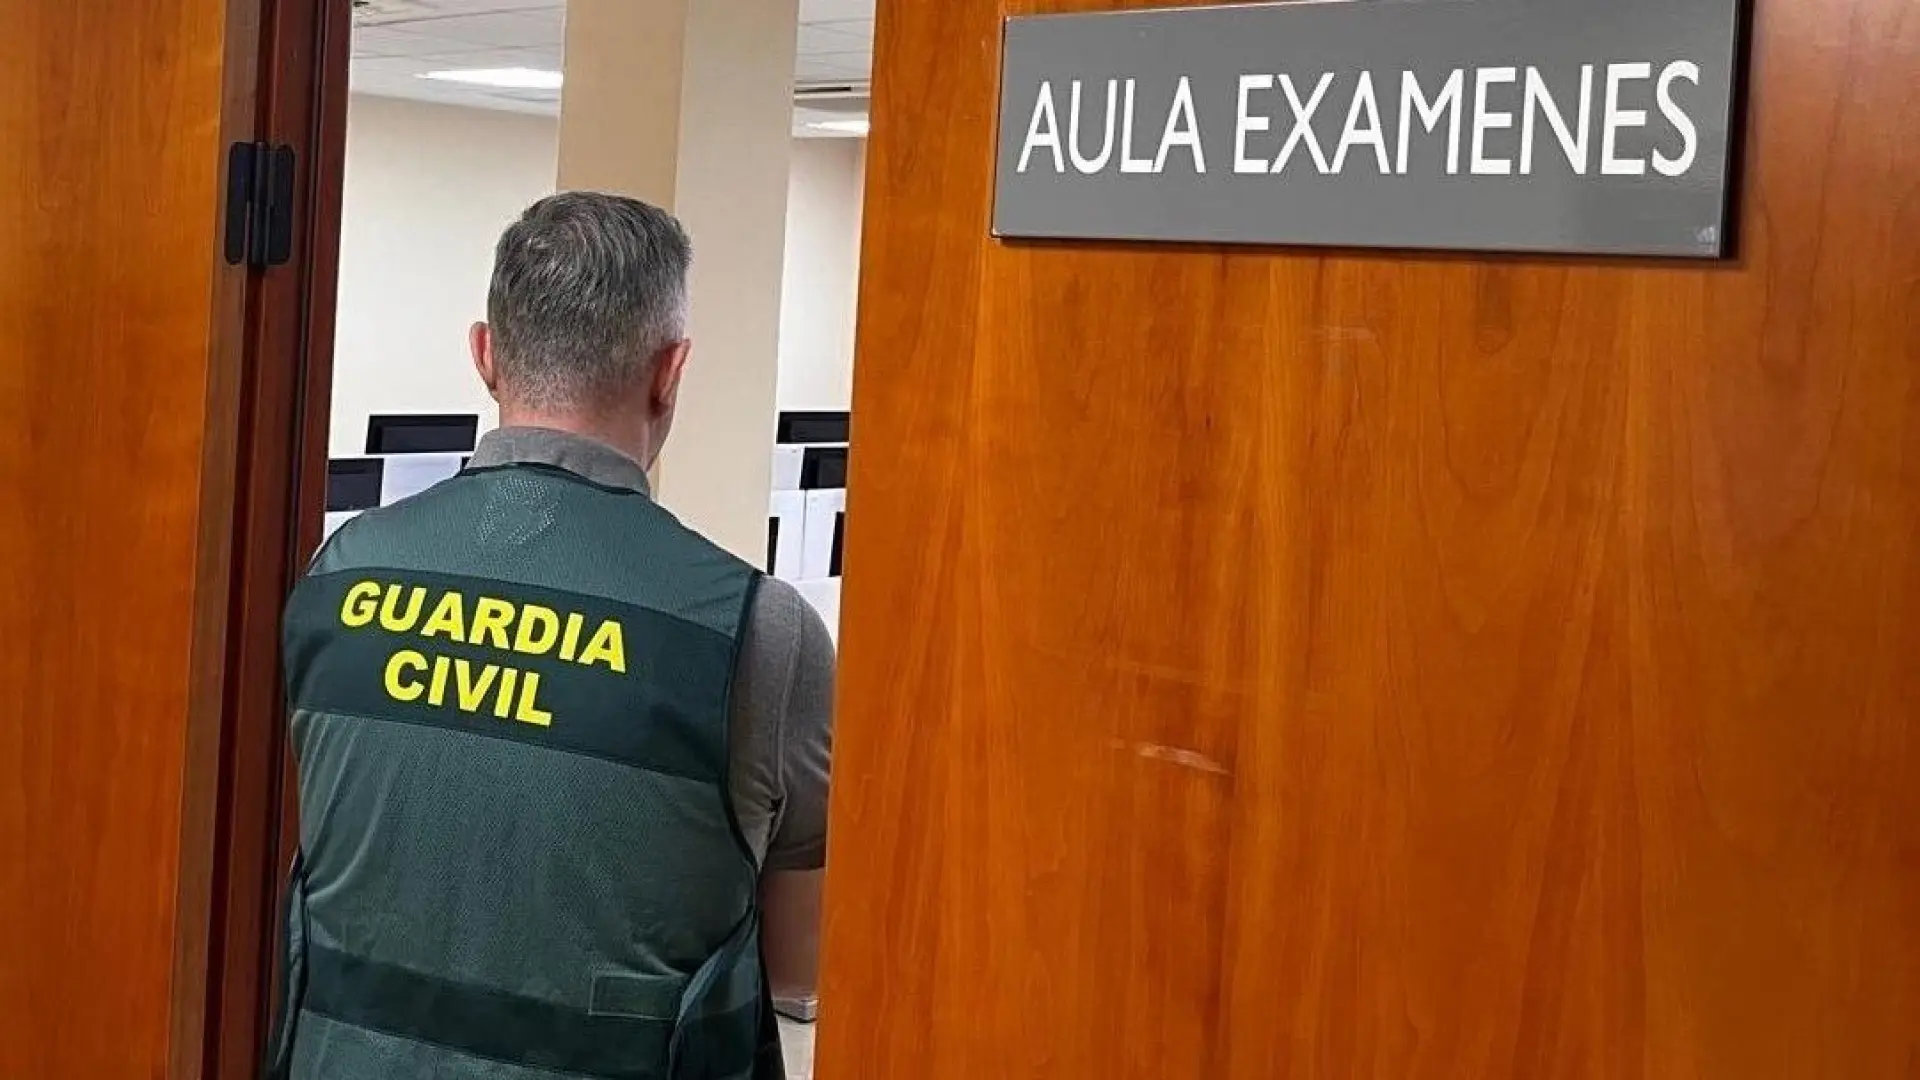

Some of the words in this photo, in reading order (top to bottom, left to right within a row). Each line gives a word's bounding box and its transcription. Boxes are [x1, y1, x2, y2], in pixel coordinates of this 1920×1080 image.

[1016, 75, 1207, 175] AULA
[1233, 59, 1700, 177] EXAMENES
[339, 580, 627, 674] GUARDIA
[383, 649, 553, 727] CIVIL
